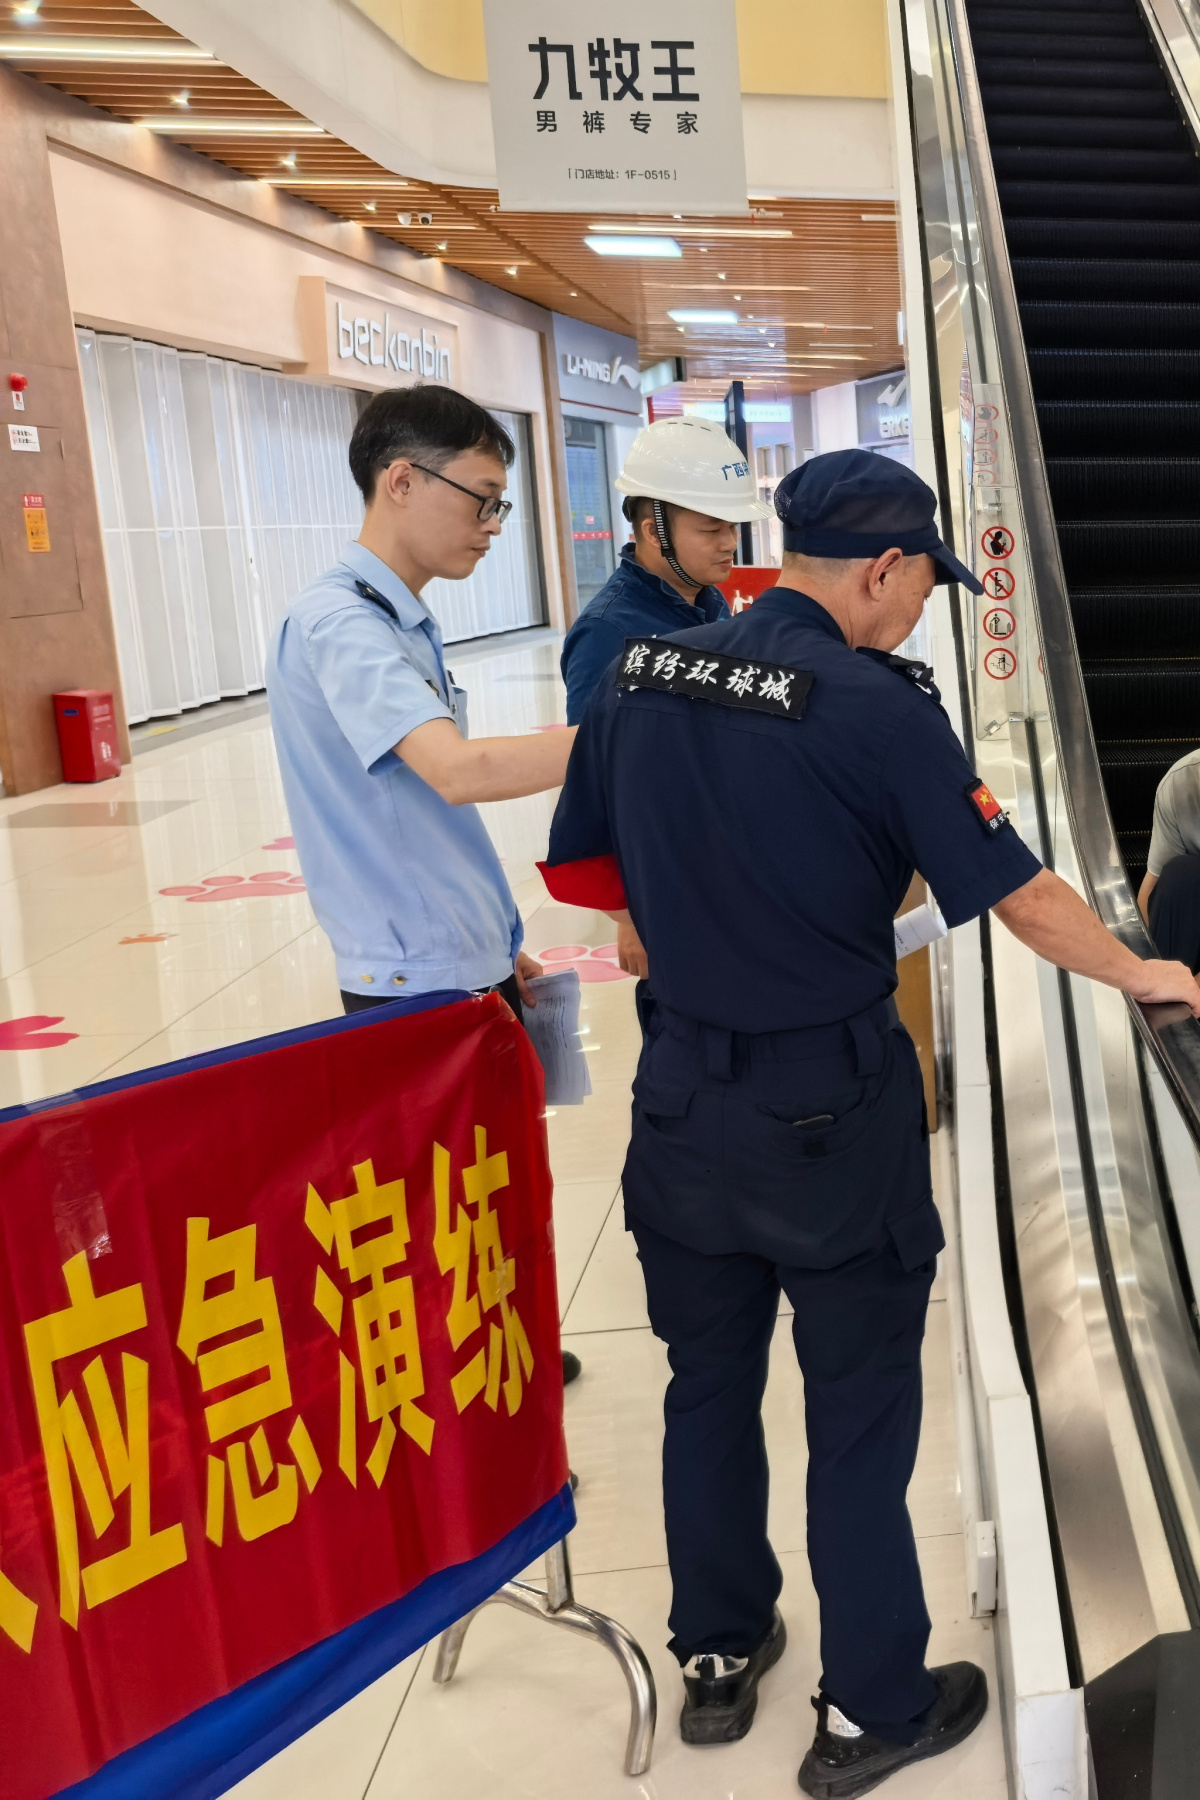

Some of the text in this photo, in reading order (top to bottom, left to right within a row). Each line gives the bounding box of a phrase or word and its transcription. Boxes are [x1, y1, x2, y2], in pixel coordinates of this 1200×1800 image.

[527, 36, 700, 102] 九牧王
[536, 110, 699, 135] 男裤专家
[336, 301, 452, 383] beckonbin
[566, 353, 612, 383] LI-NING
[623, 643, 796, 711] 缤纷环球城
[24, 1125, 535, 1630] 应急演练
